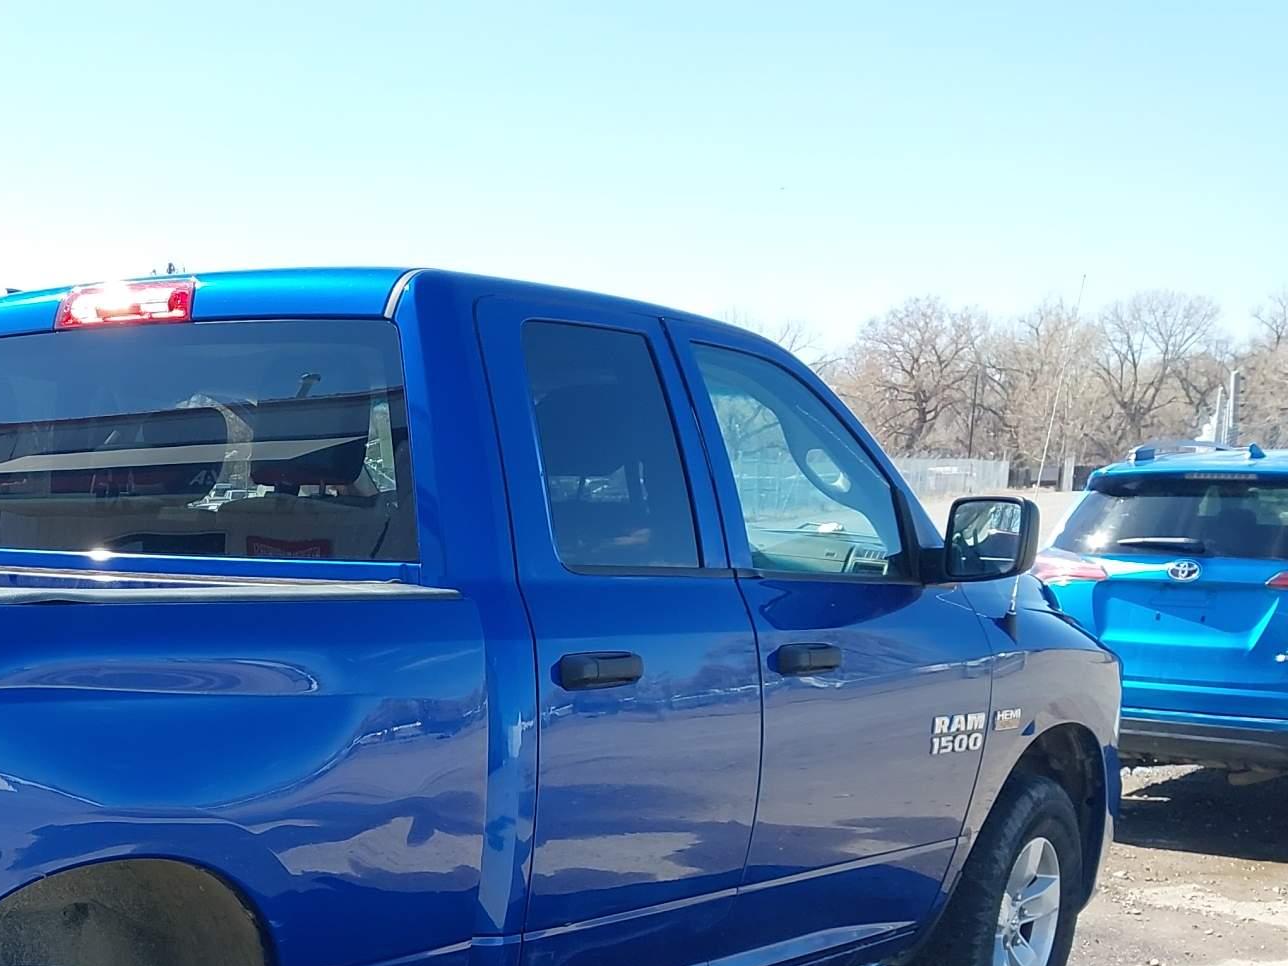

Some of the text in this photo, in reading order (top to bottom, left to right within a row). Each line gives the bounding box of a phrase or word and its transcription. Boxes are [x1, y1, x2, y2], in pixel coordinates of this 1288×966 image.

[933, 712, 986, 734] RAM
[996, 708, 1022, 721] HEMI
[931, 732, 983, 755] 1500
